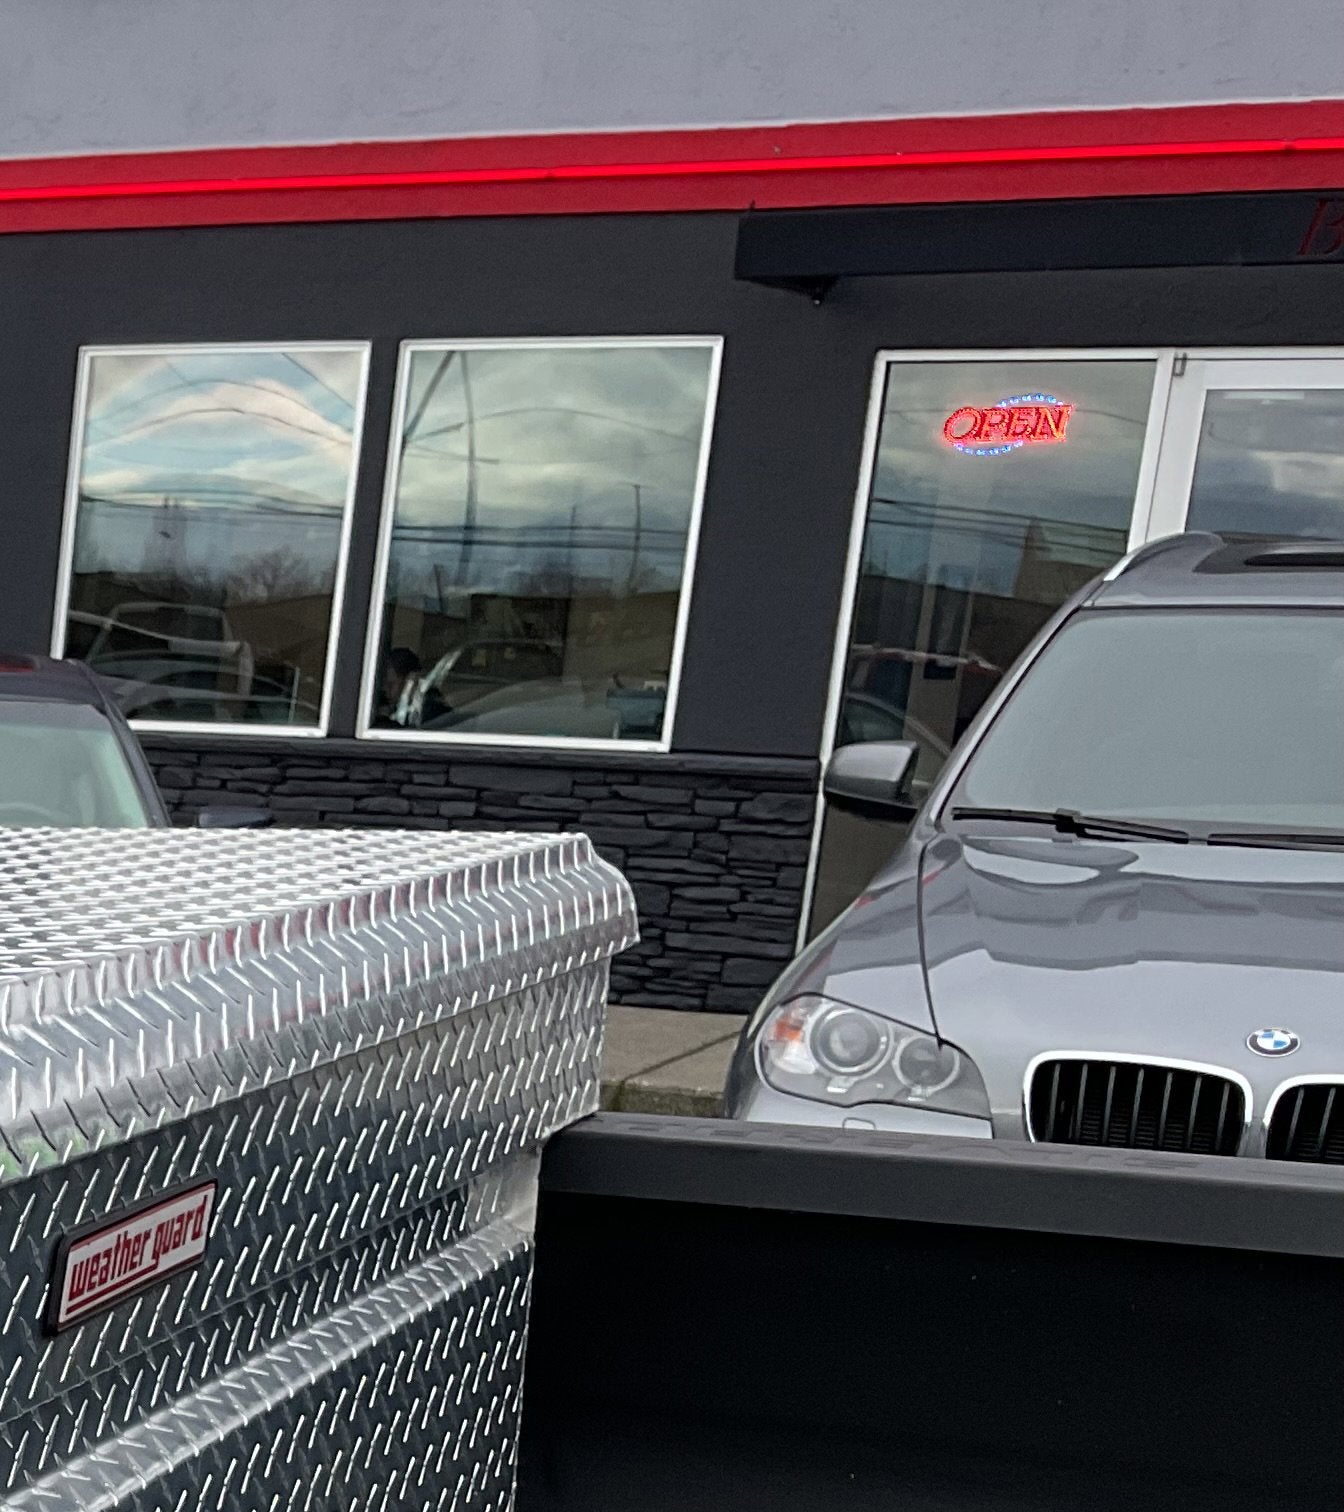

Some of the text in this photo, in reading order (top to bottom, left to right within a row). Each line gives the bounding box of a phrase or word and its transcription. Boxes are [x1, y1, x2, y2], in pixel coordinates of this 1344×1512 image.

[944, 405, 1073, 442] OPEN
[68, 1194, 208, 1302] weather guard
